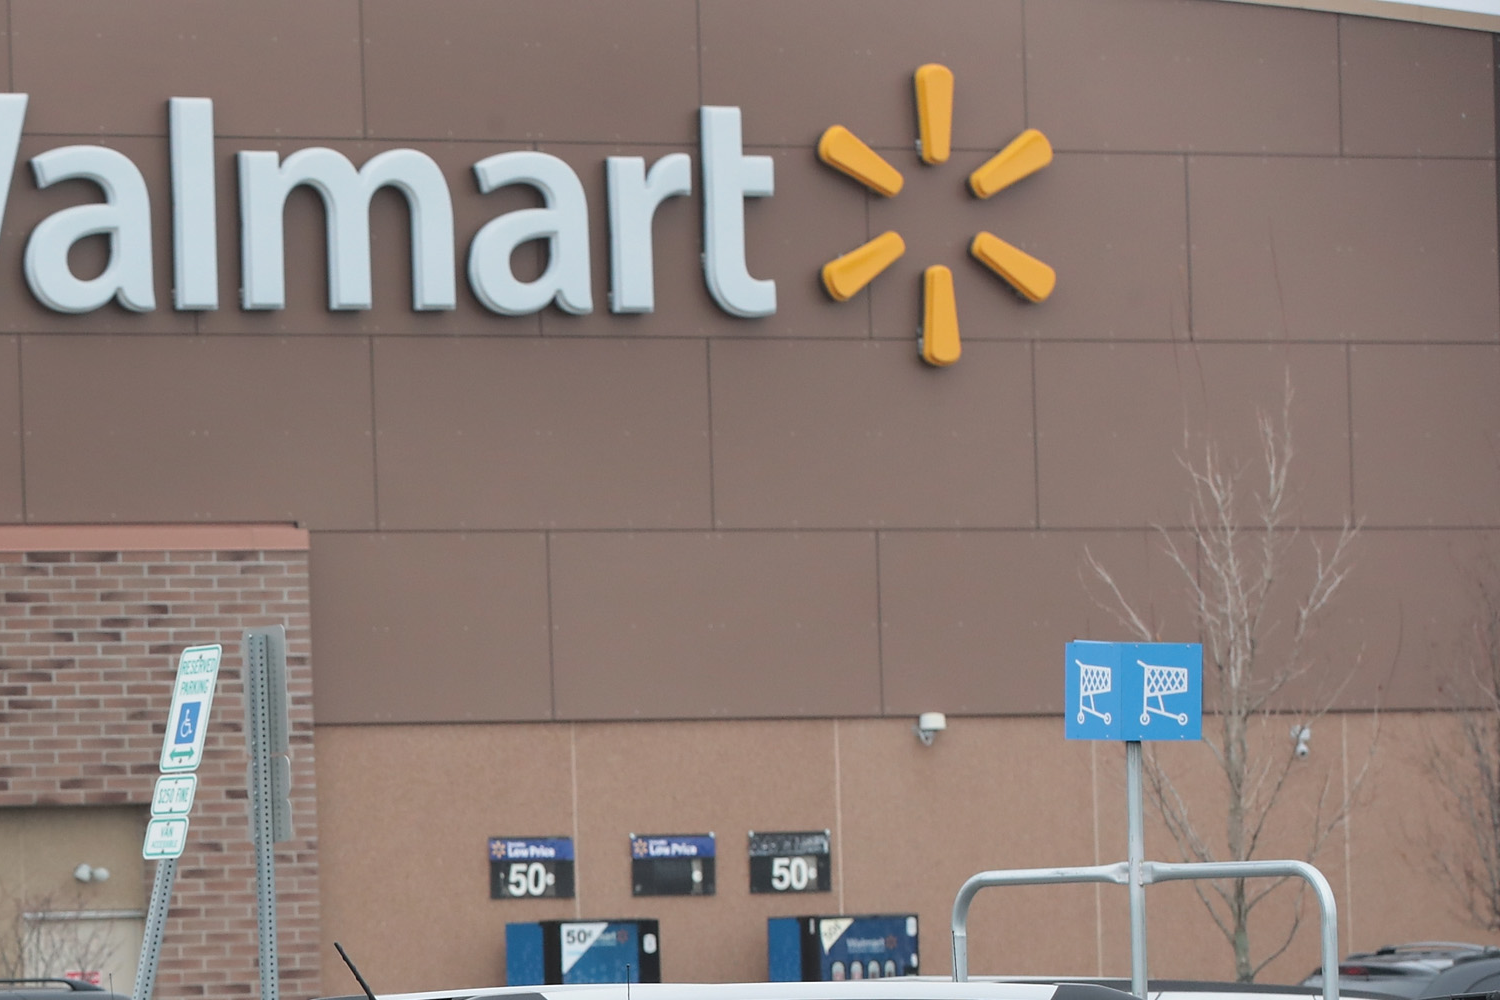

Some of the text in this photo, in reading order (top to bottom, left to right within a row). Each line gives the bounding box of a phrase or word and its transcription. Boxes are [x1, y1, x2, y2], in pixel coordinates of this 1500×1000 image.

[180, 657, 218, 676] RESERVED
[179, 679, 210, 696] PARKING
[529, 845, 556, 858] Price
[671, 842, 698, 856] Price
